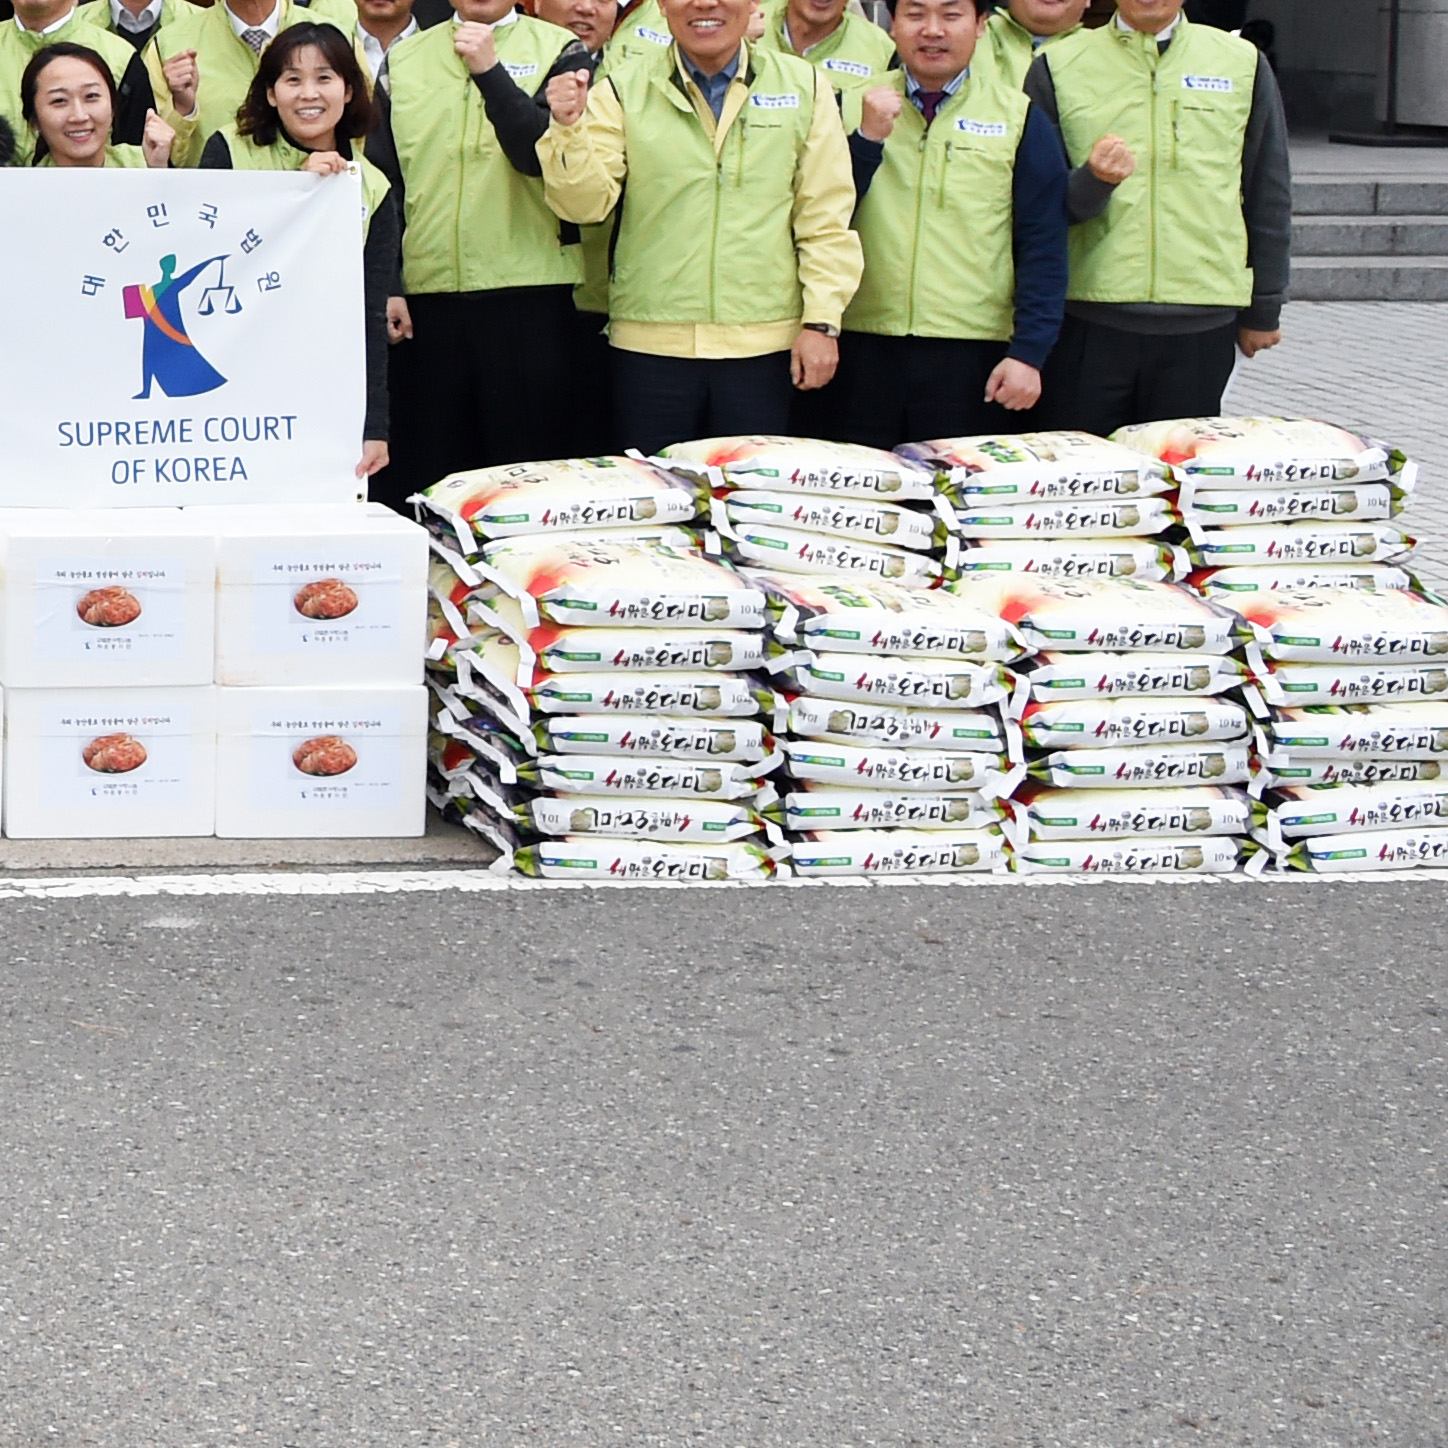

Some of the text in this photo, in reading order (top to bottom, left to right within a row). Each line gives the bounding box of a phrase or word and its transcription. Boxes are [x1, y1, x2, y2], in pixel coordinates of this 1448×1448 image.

[58, 415, 298, 447] SUPREME COURT
[111, 456, 248, 485] OF KOREA
